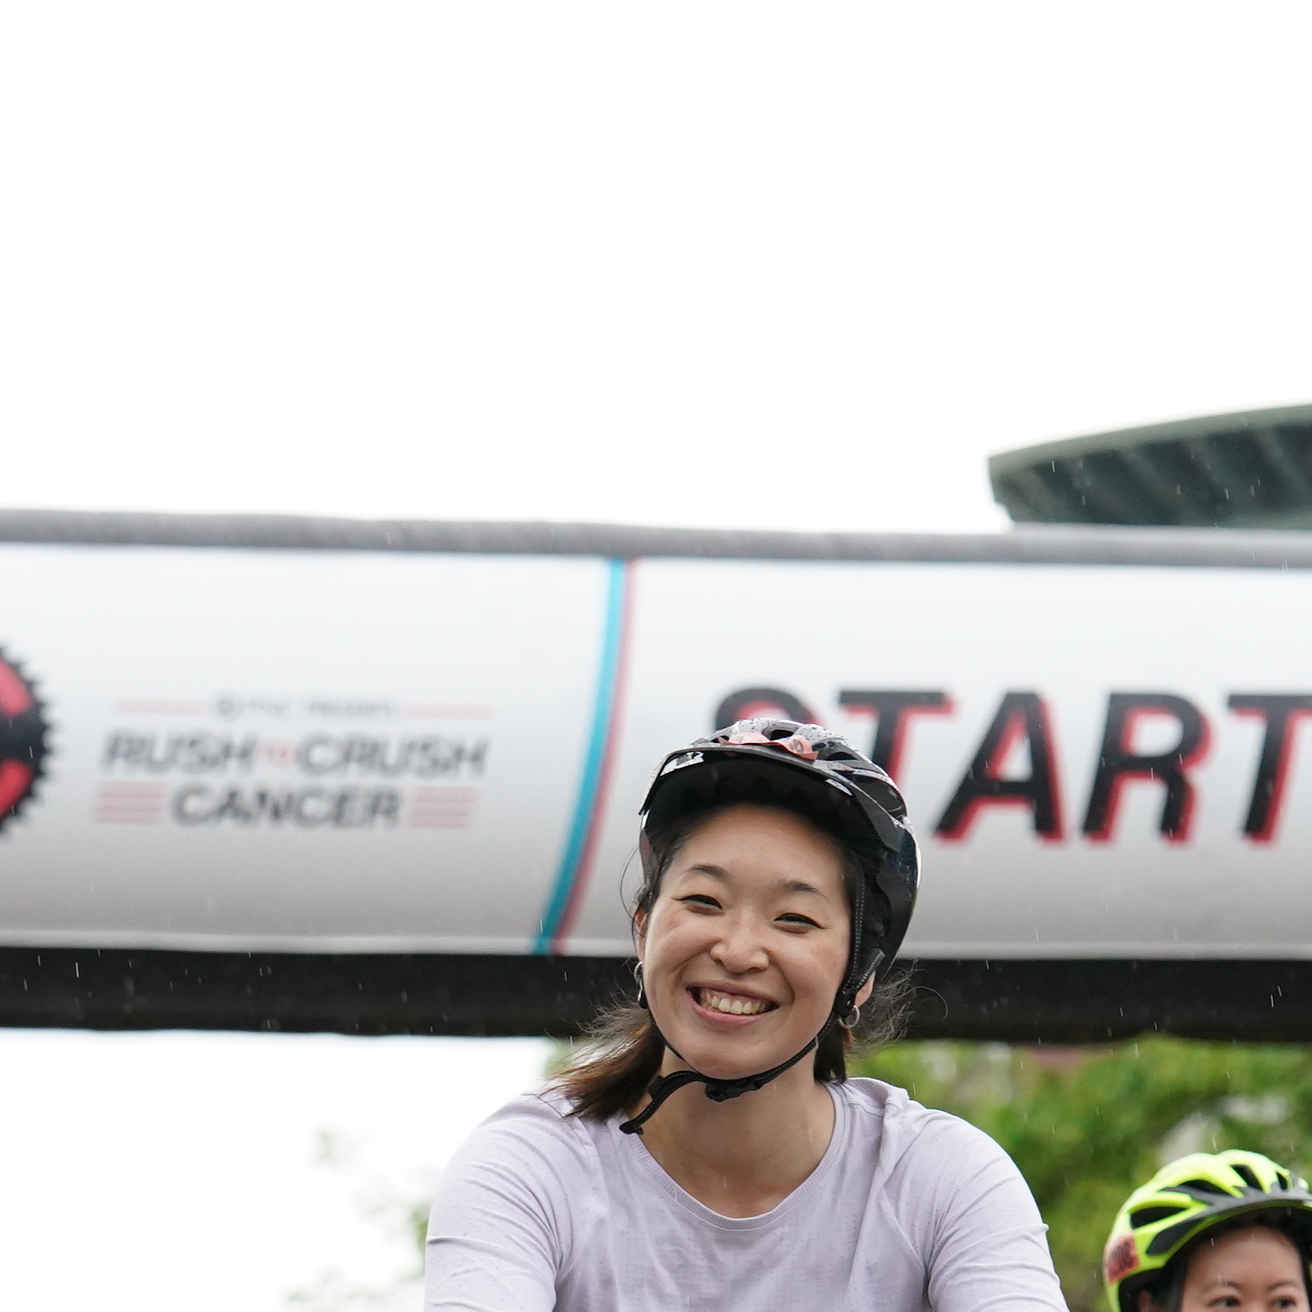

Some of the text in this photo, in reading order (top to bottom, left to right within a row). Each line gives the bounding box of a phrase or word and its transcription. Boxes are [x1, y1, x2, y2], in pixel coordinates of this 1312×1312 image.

[100, 729, 258, 774] RUSH
[298, 732, 489, 778] CRUSH
[172, 784, 404, 829] CANCER
